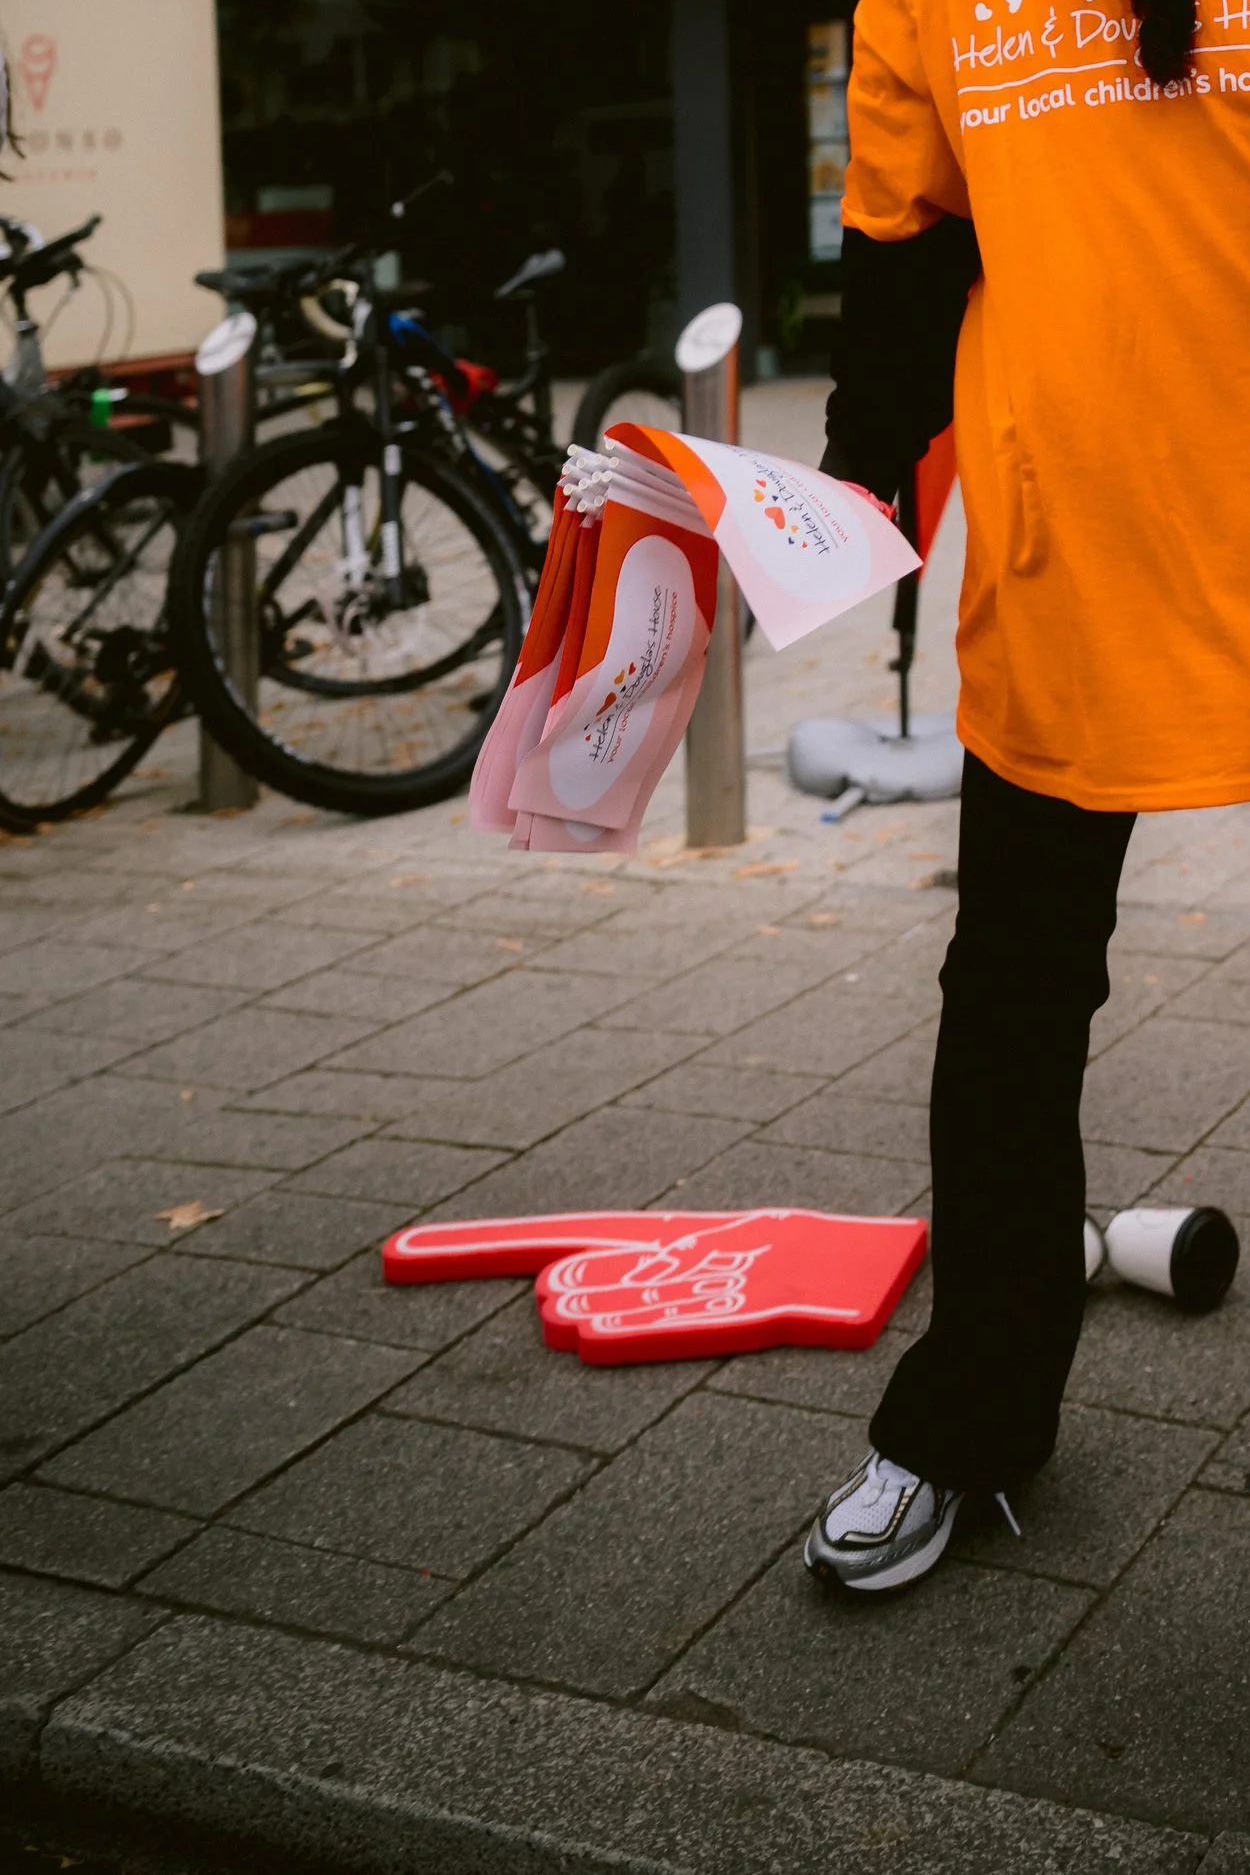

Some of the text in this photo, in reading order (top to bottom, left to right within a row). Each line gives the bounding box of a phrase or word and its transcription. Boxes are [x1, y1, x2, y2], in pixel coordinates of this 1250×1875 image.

[951, 25, 1035, 72] Helen
[1040, 6, 1064, 58] &
[1018, 83, 1076, 120] local
[801, 512, 830, 555] Helen
[622, 640, 655, 698] Douglas
[647, 585, 662, 637] House
[607, 734, 622, 764] your
[666, 590, 678, 640] hospice
